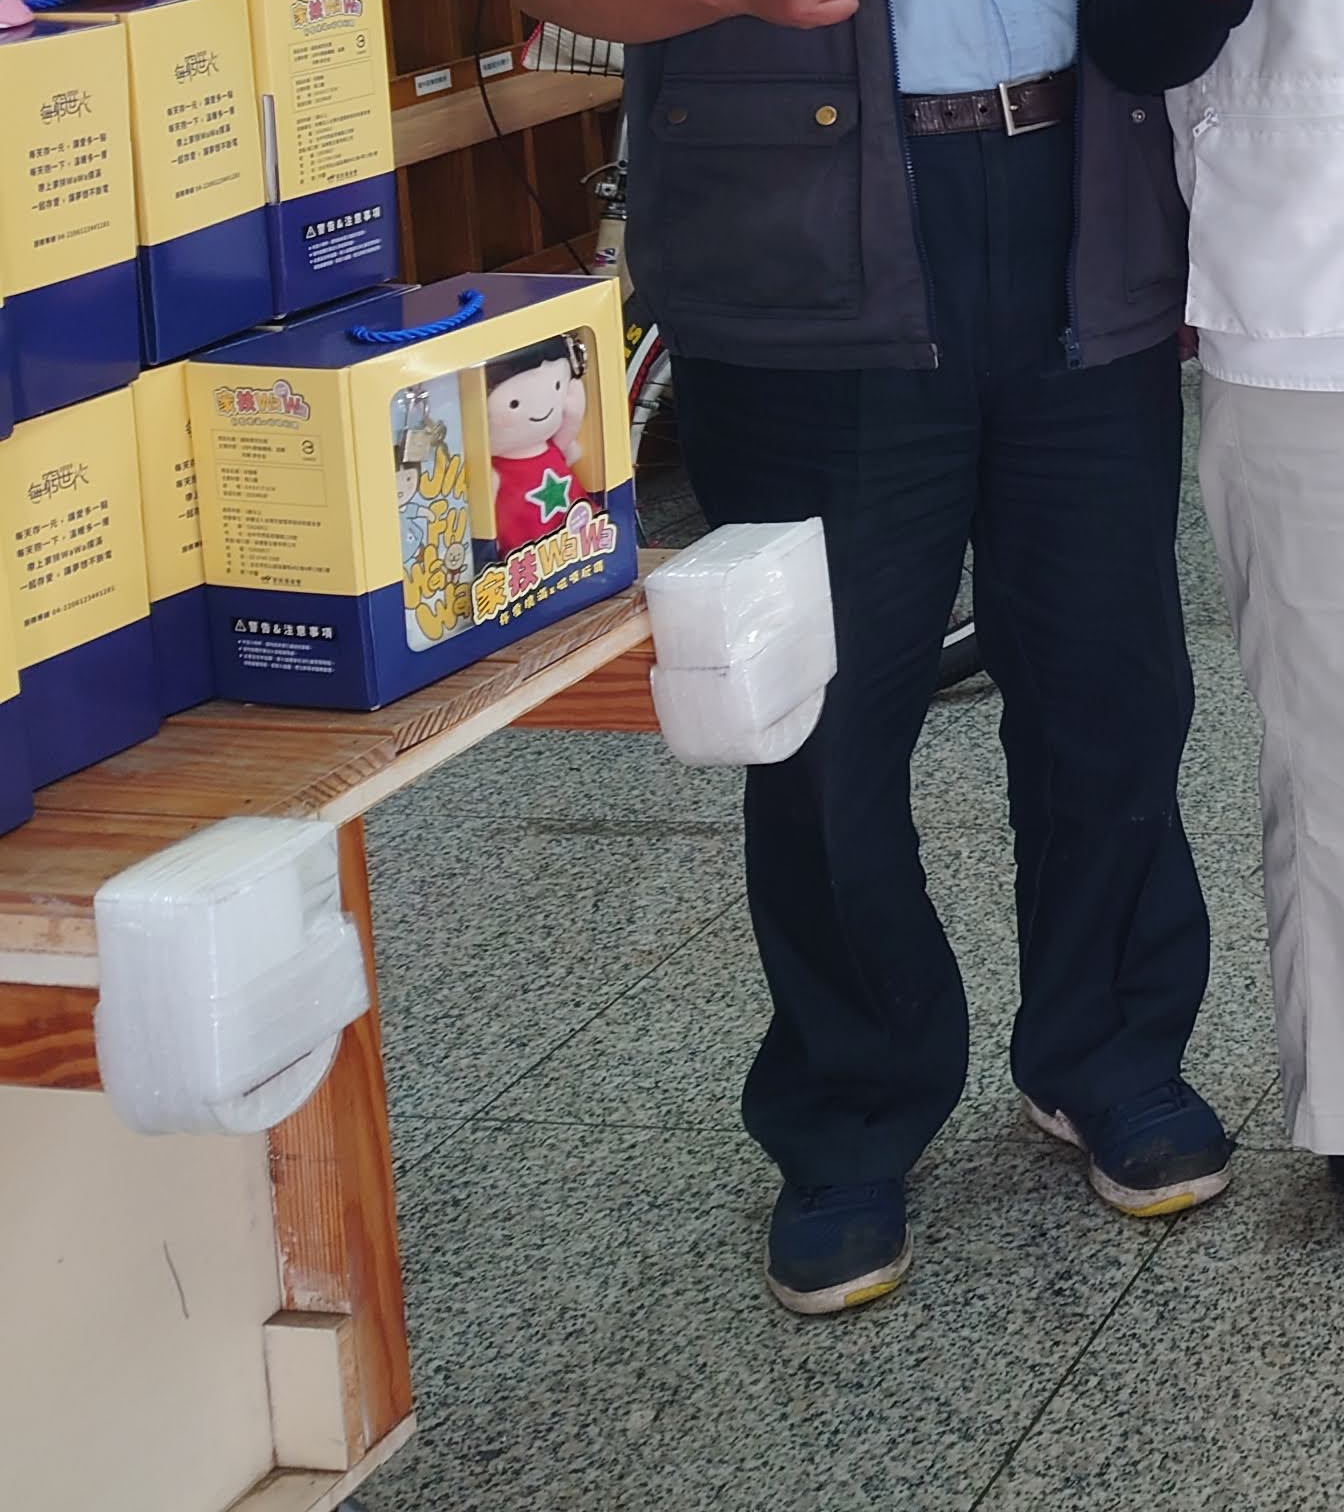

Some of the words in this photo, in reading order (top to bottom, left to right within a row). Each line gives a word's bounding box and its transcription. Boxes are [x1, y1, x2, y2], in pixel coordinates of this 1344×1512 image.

[248, 620, 333, 640] 警告&注意事項
